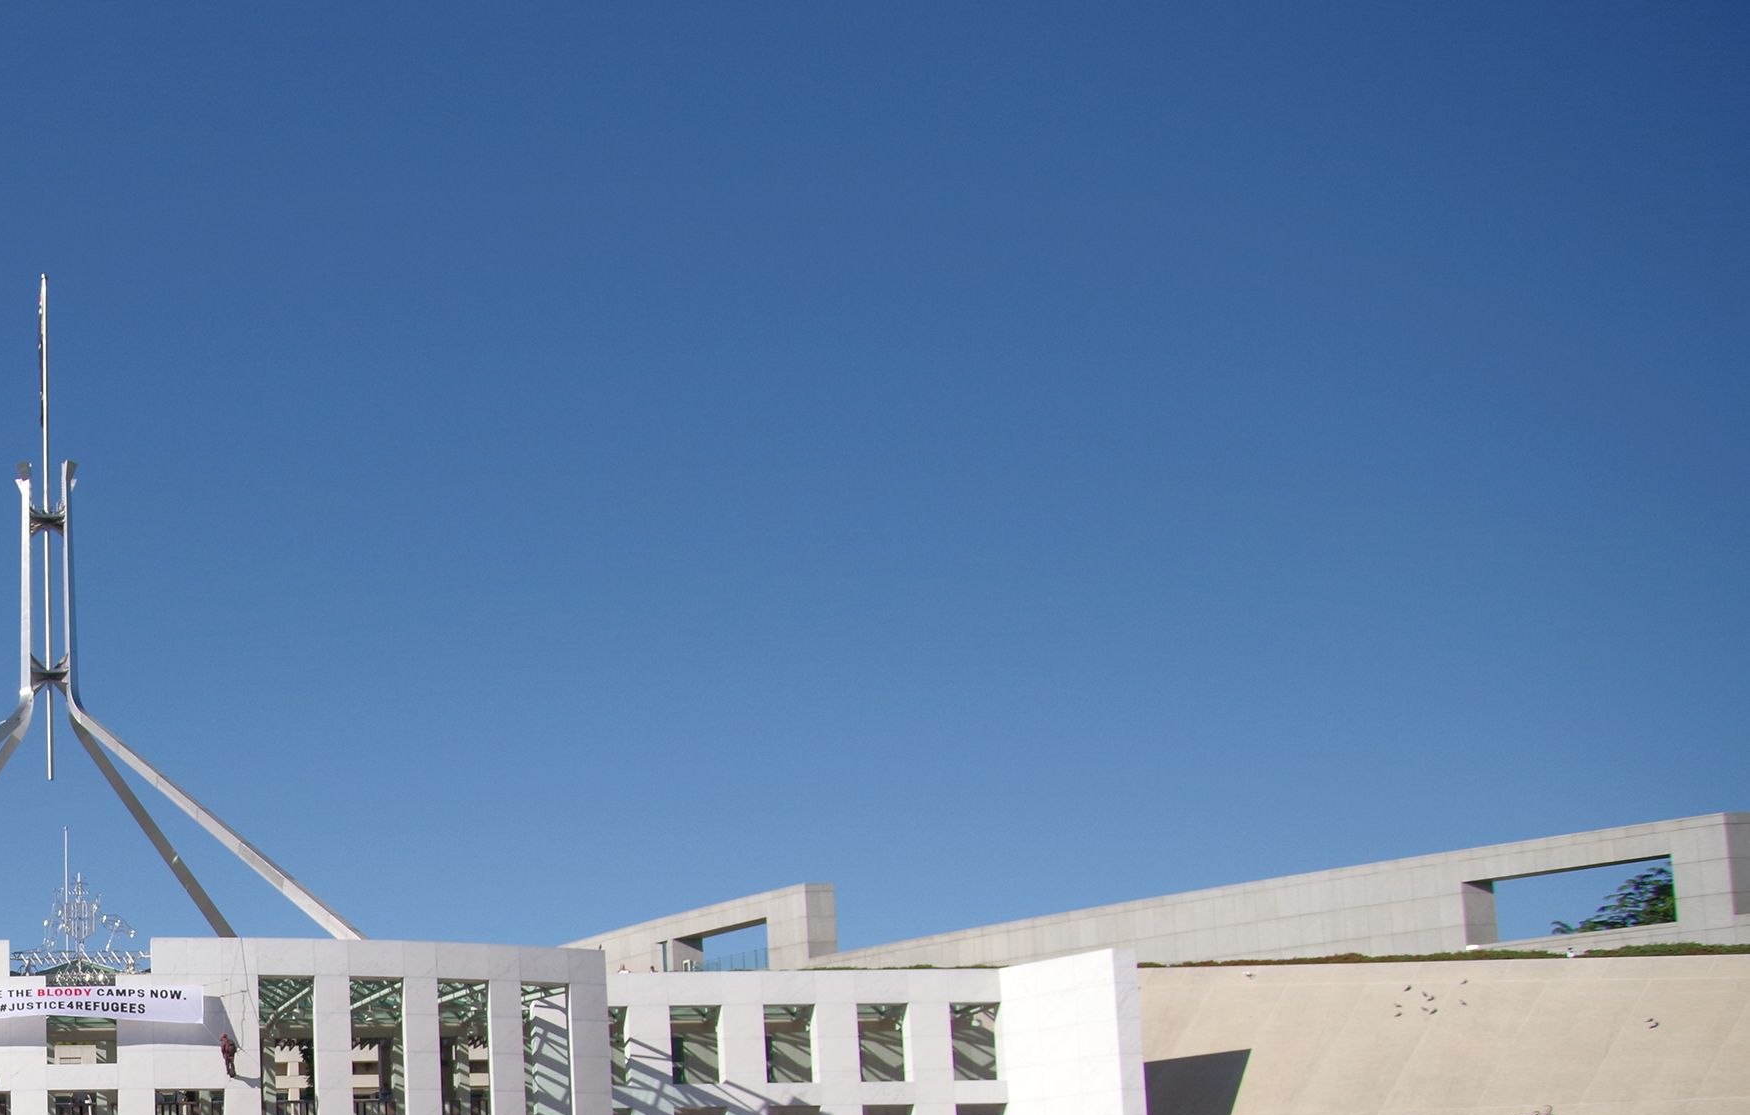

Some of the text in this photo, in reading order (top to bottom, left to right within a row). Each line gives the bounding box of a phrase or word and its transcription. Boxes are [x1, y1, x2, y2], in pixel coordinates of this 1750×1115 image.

[8, 989, 33, 998] THE
[37, 988, 92, 997] BLOODY
[97, 988, 145, 998] CAMPS
[150, 989, 187, 1000] NOW.
[0, 1001, 146, 1014] #JUSTICE4REFUGEES
